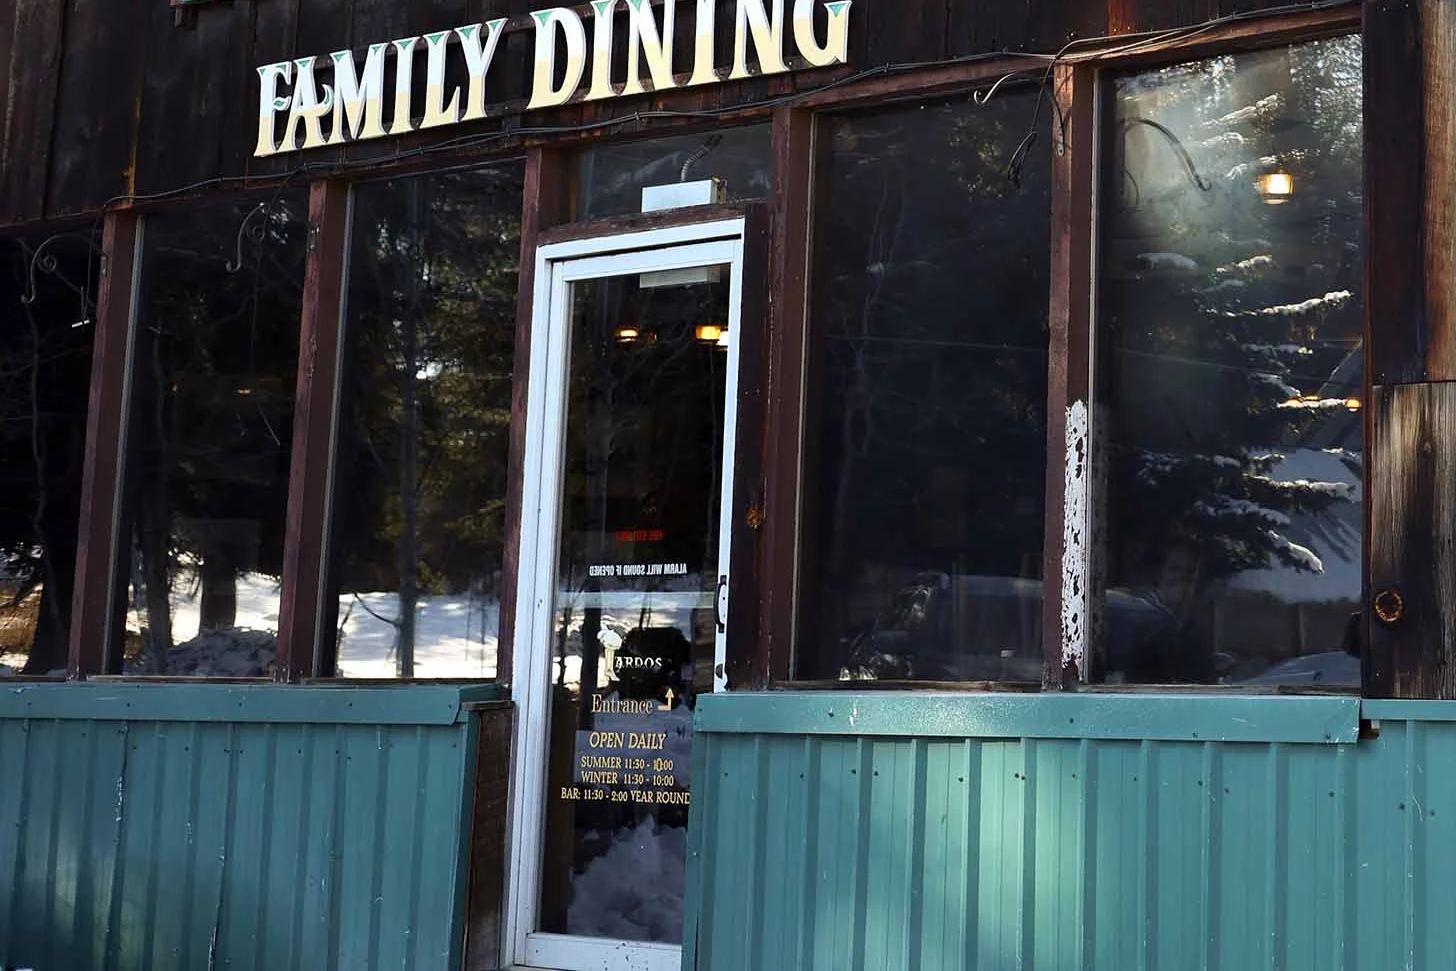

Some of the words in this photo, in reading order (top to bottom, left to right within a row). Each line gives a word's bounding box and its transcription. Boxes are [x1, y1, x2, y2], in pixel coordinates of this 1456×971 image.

[253, 16, 509, 157] FAMILY
[591, 694, 653, 714] Entrance
[589, 731, 625, 748] OPEN
[628, 732, 667, 749] DAILY
[580, 756, 622, 769] SUMMER
[624, 758, 645, 770] 11:30
[580, 771, 618, 784] WINTER
[623, 774, 644, 785] 11:30
[653, 775, 675, 786] 10:00
[560, 787, 581, 800] BAR:
[583, 789, 604, 800] 11:30
[611, 791, 628, 802] 2:00
[630, 790, 654, 803] YEAR
